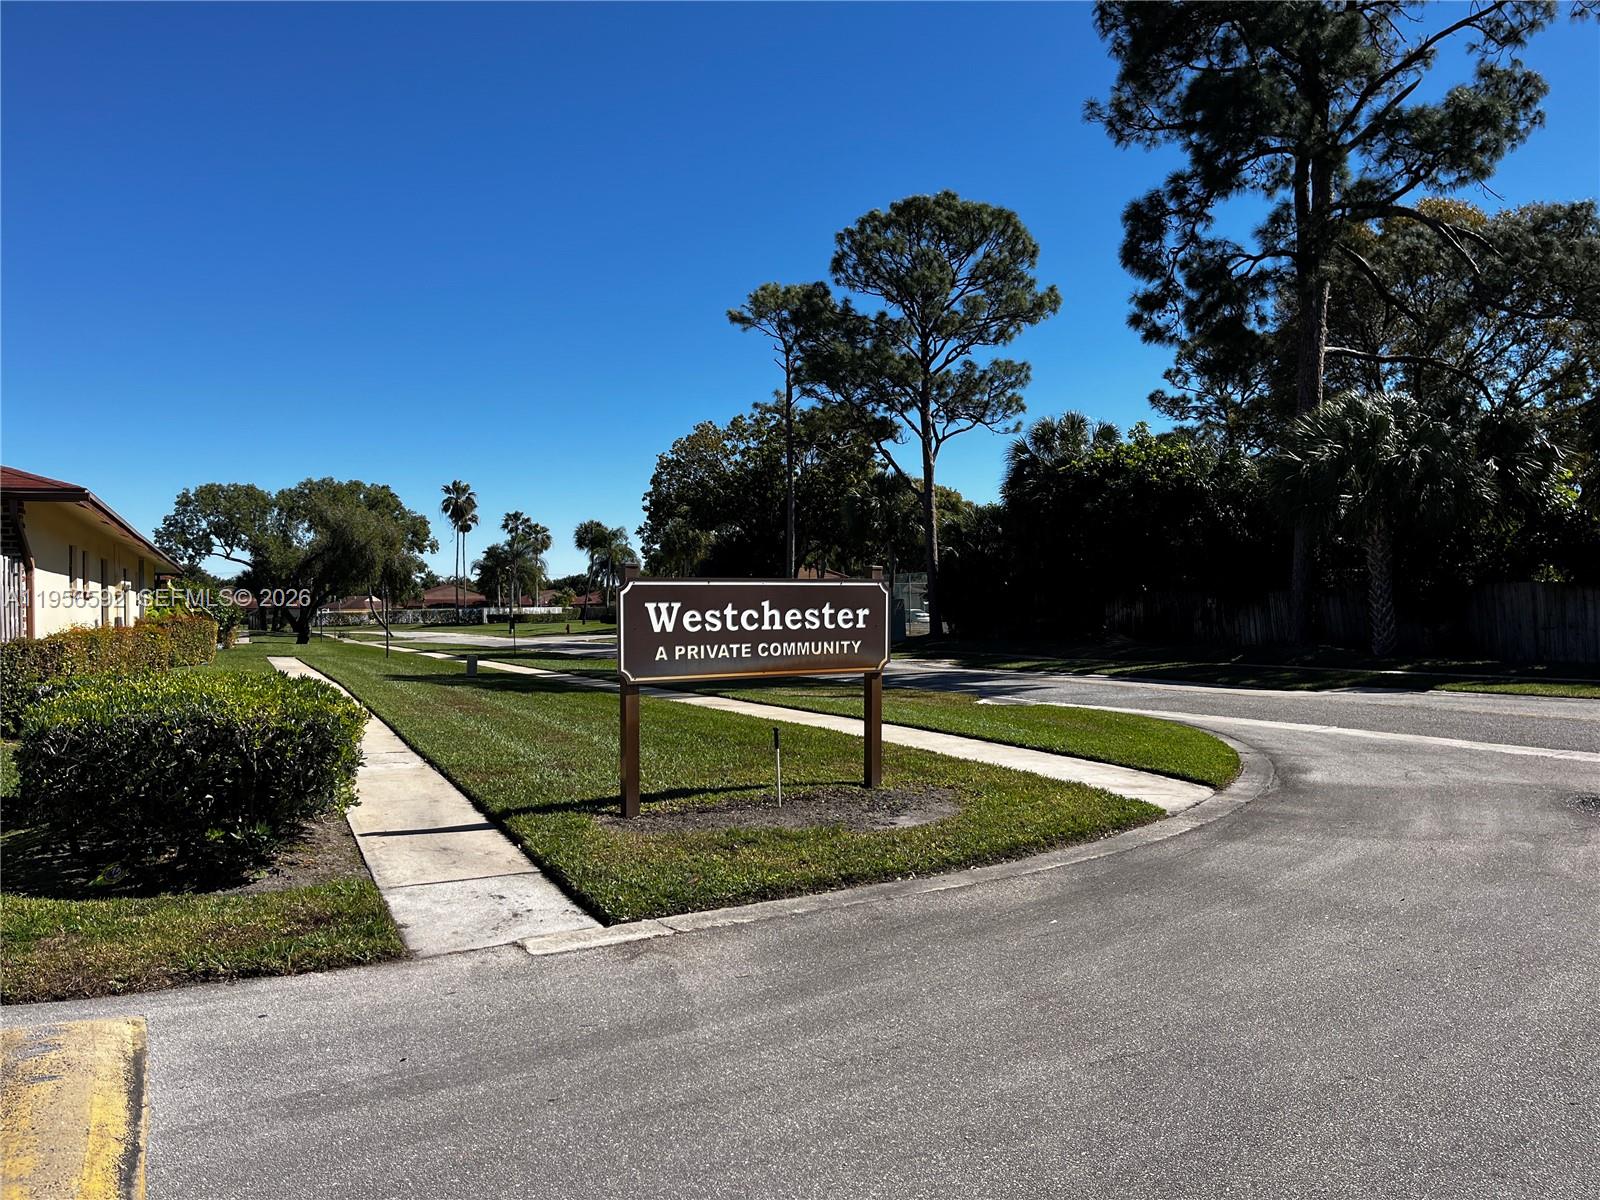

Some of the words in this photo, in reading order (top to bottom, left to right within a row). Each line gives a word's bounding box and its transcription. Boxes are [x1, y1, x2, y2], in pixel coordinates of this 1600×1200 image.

[644, 600, 870, 633] Westchester
[655, 646, 668, 661] A
[674, 643, 752, 660] PRIVATE
[757, 640, 862, 657] COMMUNITY
